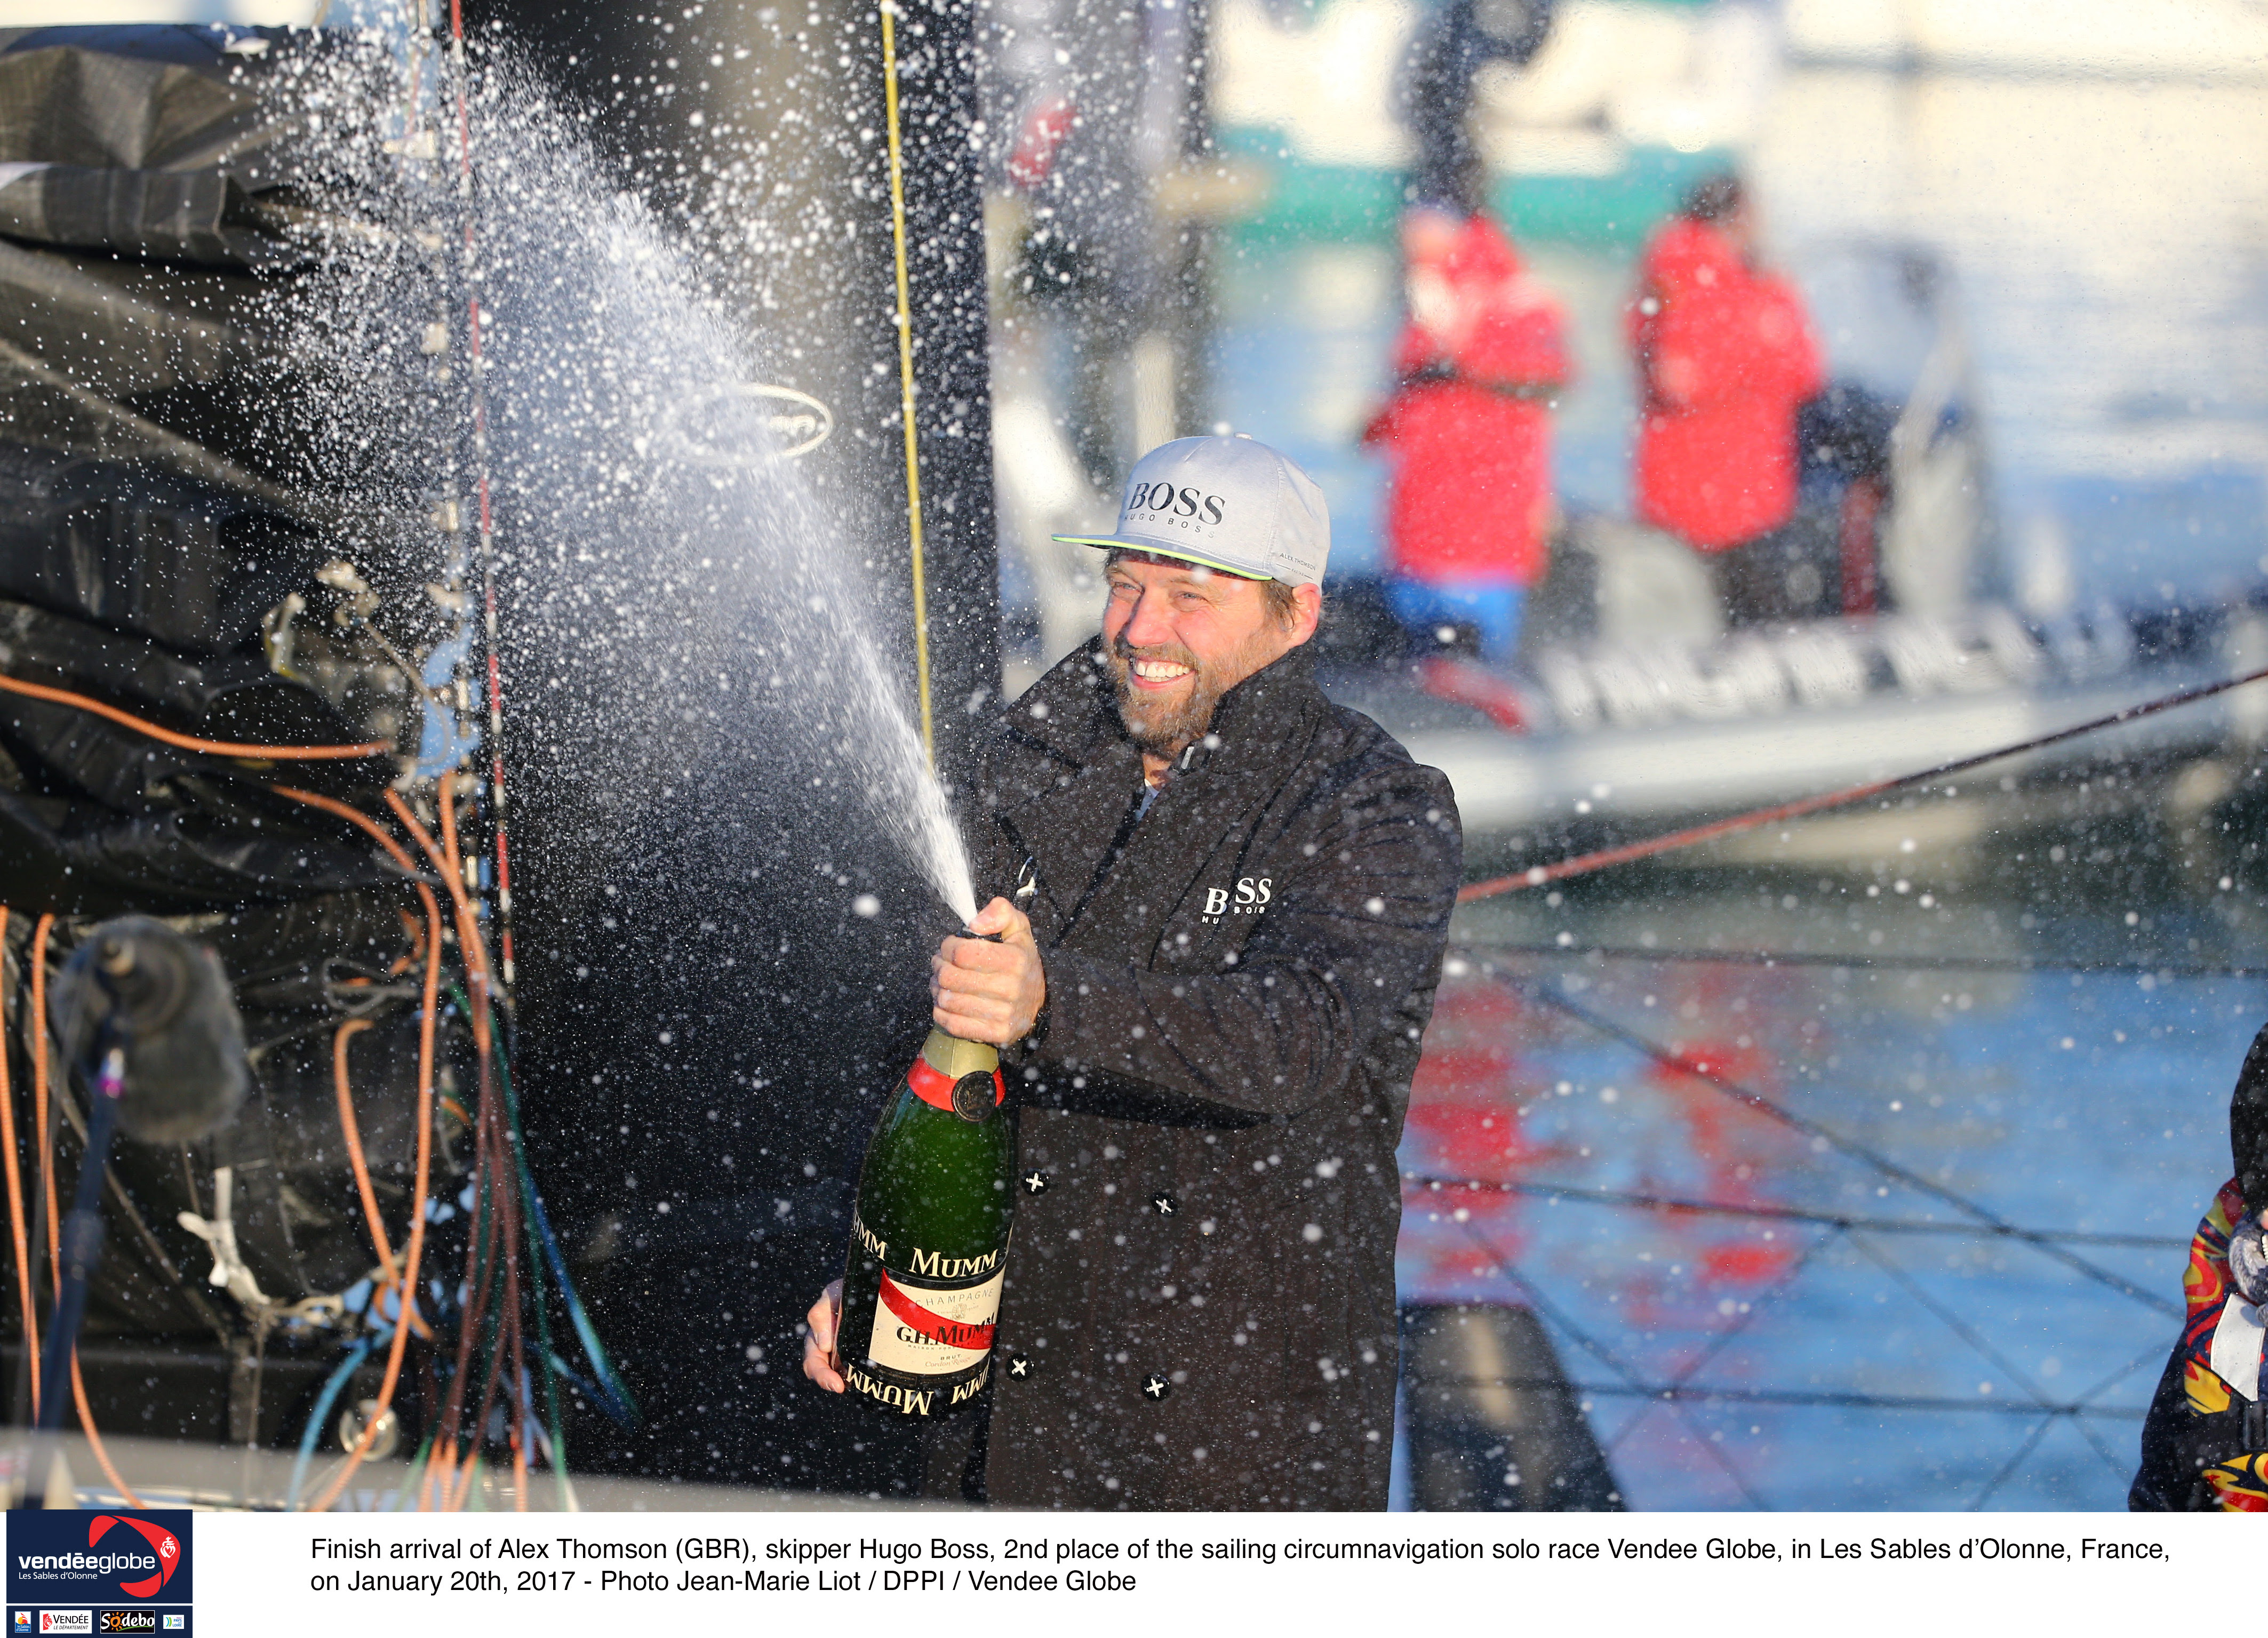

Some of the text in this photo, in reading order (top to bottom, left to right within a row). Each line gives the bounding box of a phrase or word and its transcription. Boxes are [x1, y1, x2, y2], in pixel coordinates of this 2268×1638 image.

[1127, 482, 1225, 525] BOSS
[1124, 513, 1215, 538] HUGO BOSS
[1279, 553, 1316, 571] ALEX THOMSON
[1202, 877, 1273, 915] BSS
[908, 1247, 999, 1278] MUMM
[915, 1288, 994, 1308] CHAMPAGNE
[845, 1362, 934, 1416] MUMM
